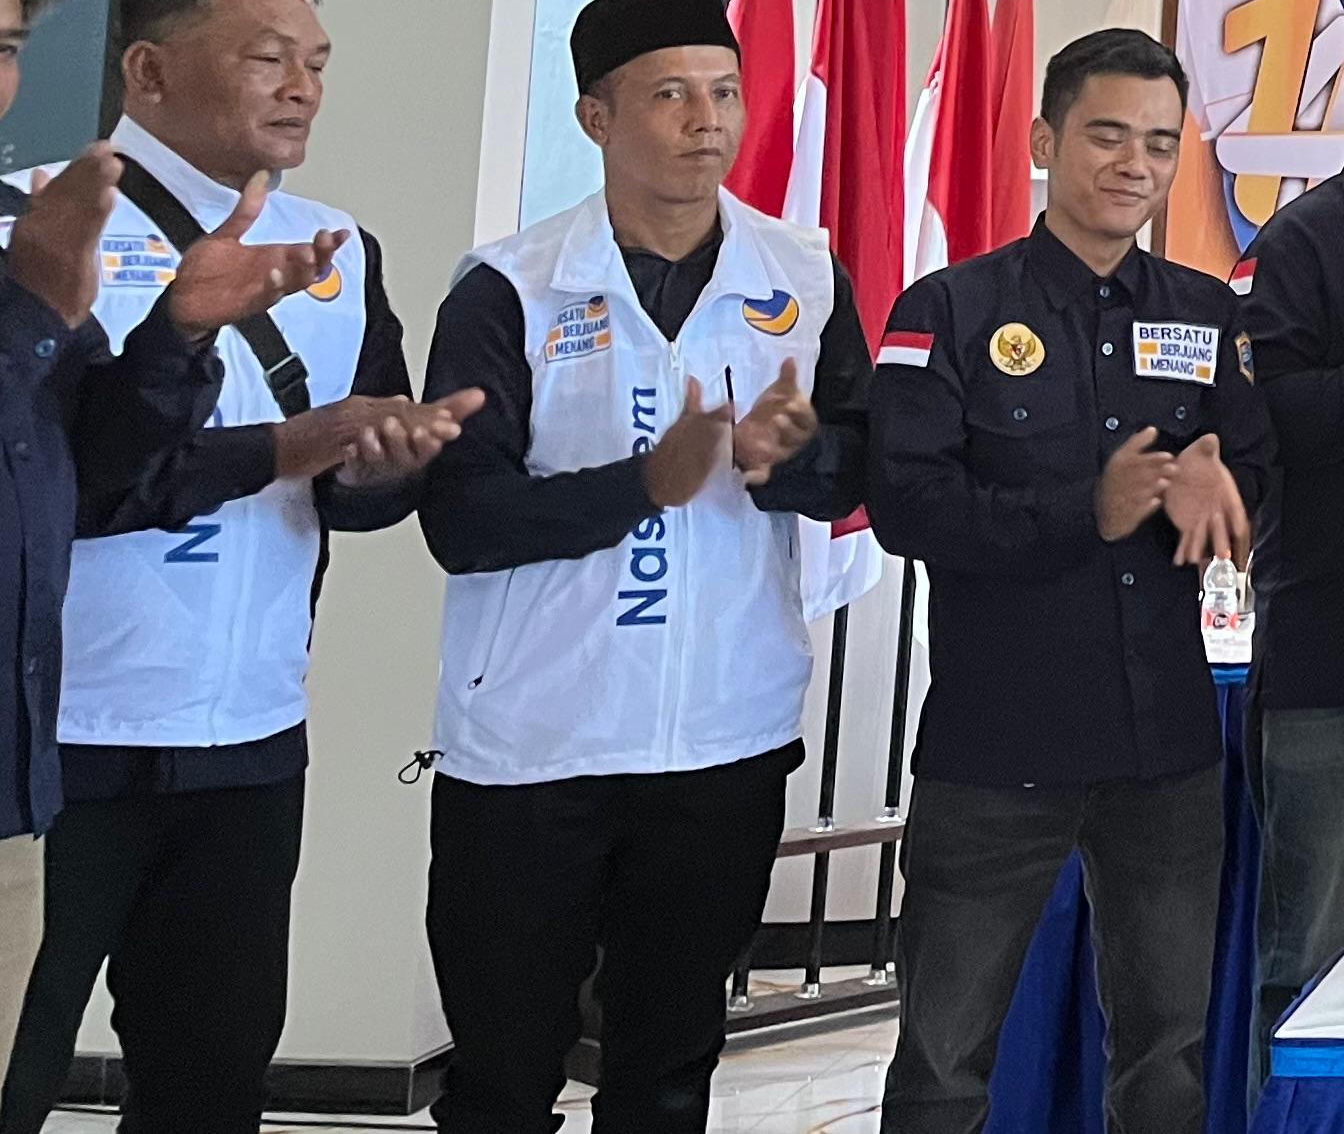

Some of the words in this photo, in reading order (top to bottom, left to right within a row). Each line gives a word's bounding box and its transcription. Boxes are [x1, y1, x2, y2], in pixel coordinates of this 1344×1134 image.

[1139, 326, 1213, 345] BERSATU
[1160, 343, 1213, 363] BERJUANG
[1150, 357, 1194, 376] MENANG
[616, 386, 668, 627] Nasem
